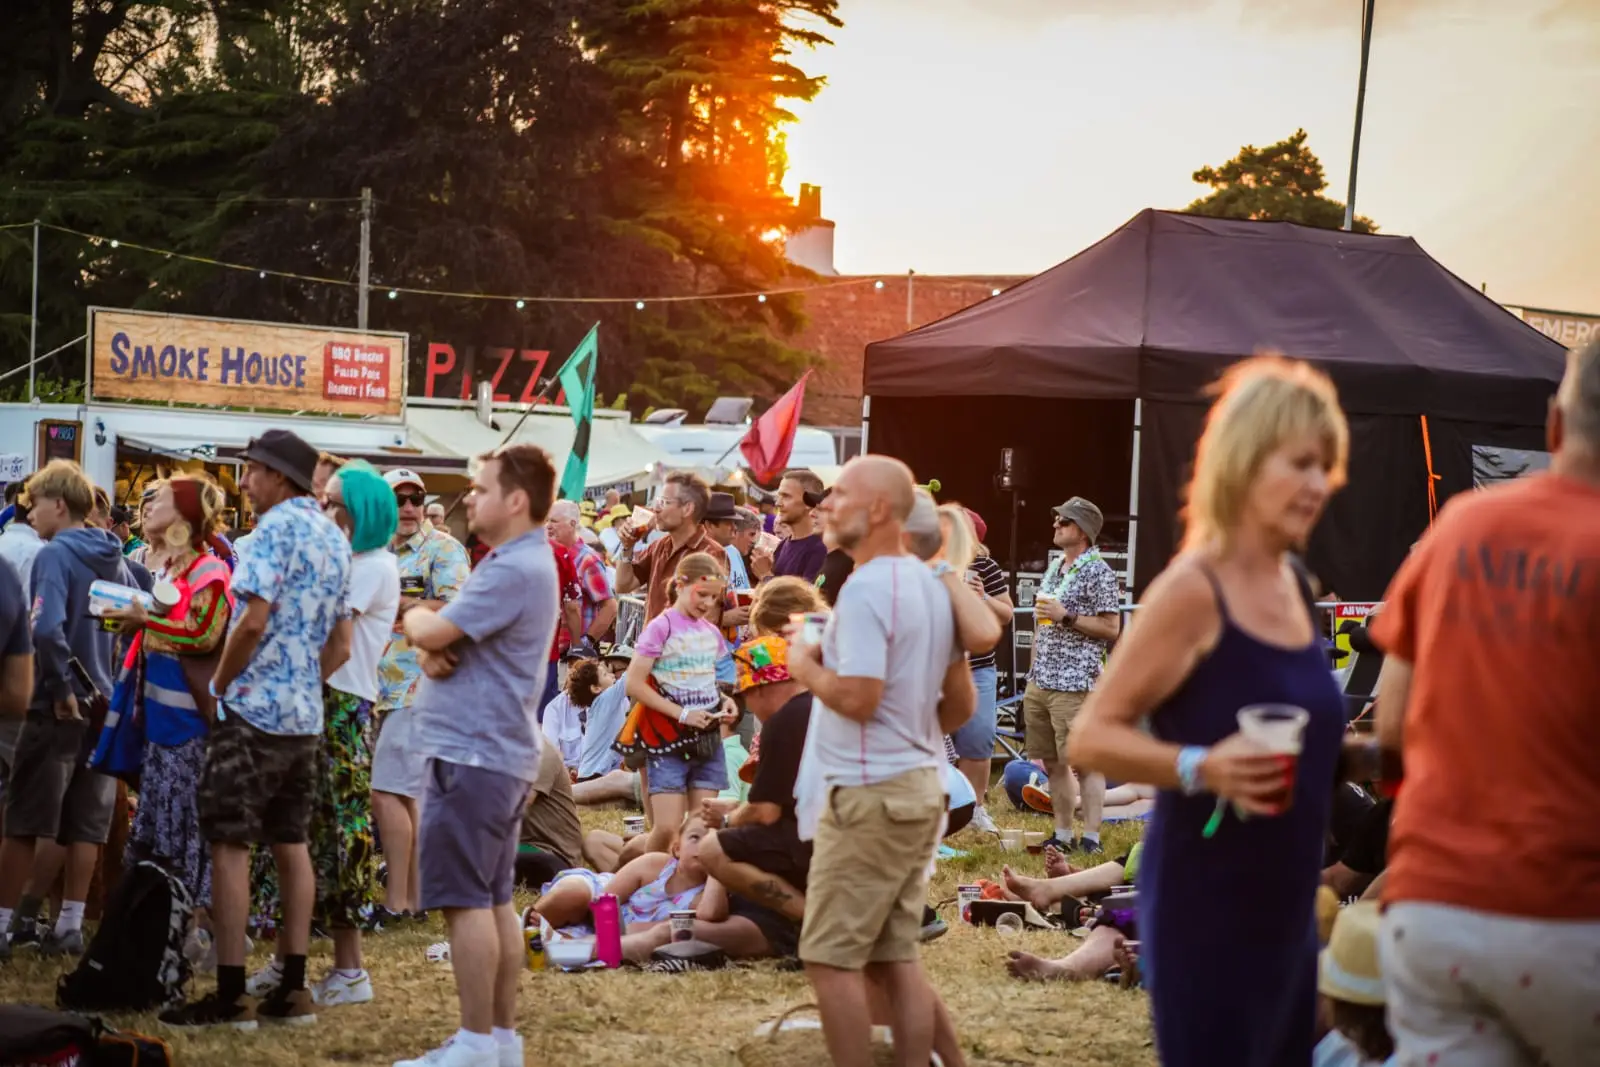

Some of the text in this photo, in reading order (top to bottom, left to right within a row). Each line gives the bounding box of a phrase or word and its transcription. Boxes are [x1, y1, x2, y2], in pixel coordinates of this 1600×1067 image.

[110, 331, 308, 388] SMOKE HOUSE
[331, 346, 351, 361] BBQ
[424, 342, 566, 405] PIZZ
[1342, 605, 1355, 616] All
